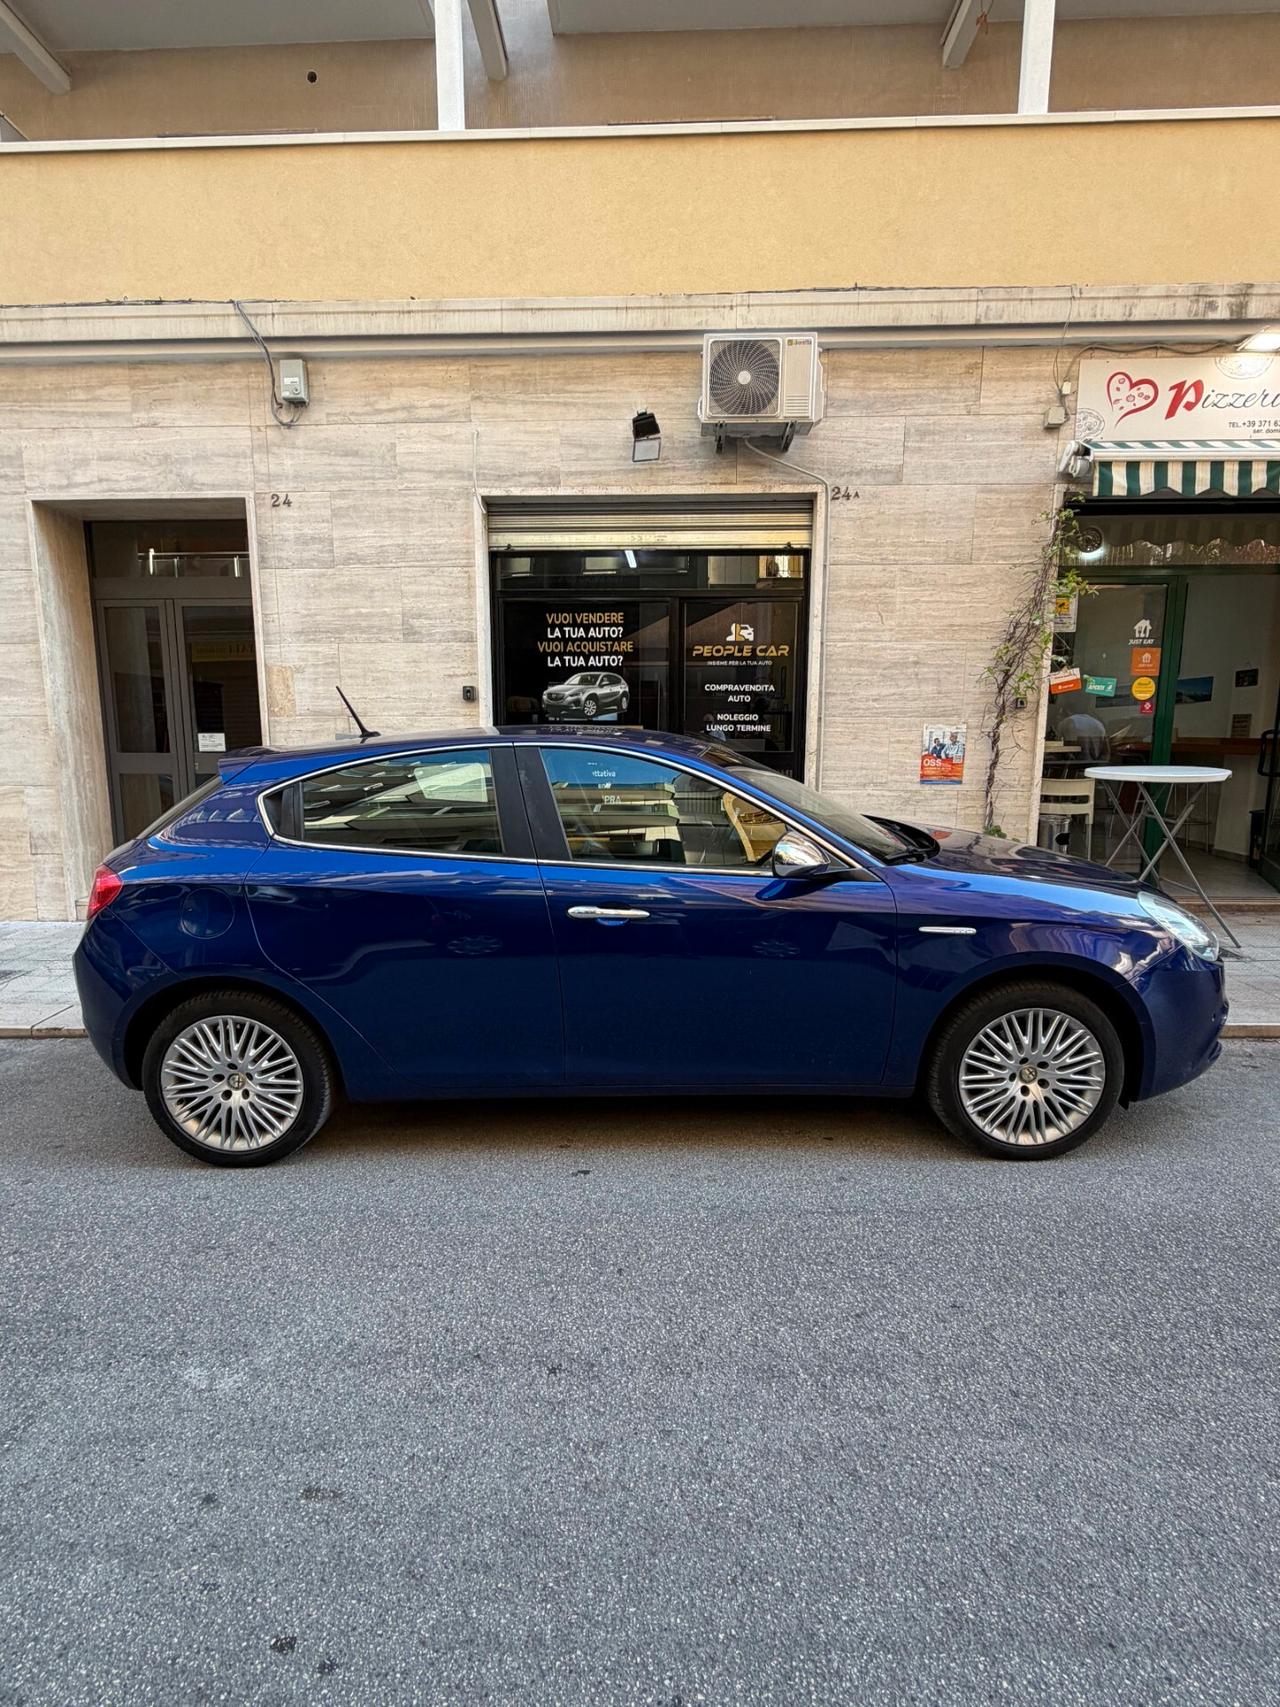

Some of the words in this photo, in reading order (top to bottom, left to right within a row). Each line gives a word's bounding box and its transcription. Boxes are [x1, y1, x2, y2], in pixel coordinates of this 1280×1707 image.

[271, 493, 293, 507] 24
[546, 613, 573, 624] VUOI
[575, 612, 624, 624] VENDERE
[547, 627, 561, 638] LA
[563, 627, 586, 638] TUA
[588, 626, 624, 638] AUTO?
[537, 641, 564, 653] VUOI
[566, 641, 634, 655] ACQUISTARE
[692, 645, 753, 657] PEOPLE
[756, 645, 790, 657] CAR
[547, 655, 561, 667] LA
[563, 655, 586, 667] TUA
[588, 655, 624, 667] AUTO?
[704, 684, 775, 692] COMPRAVENDITA
[716, 713, 759, 721] NOLEGGIO
[706, 724, 735, 732] LUNGO
[736, 724, 771, 732] TERMINE
